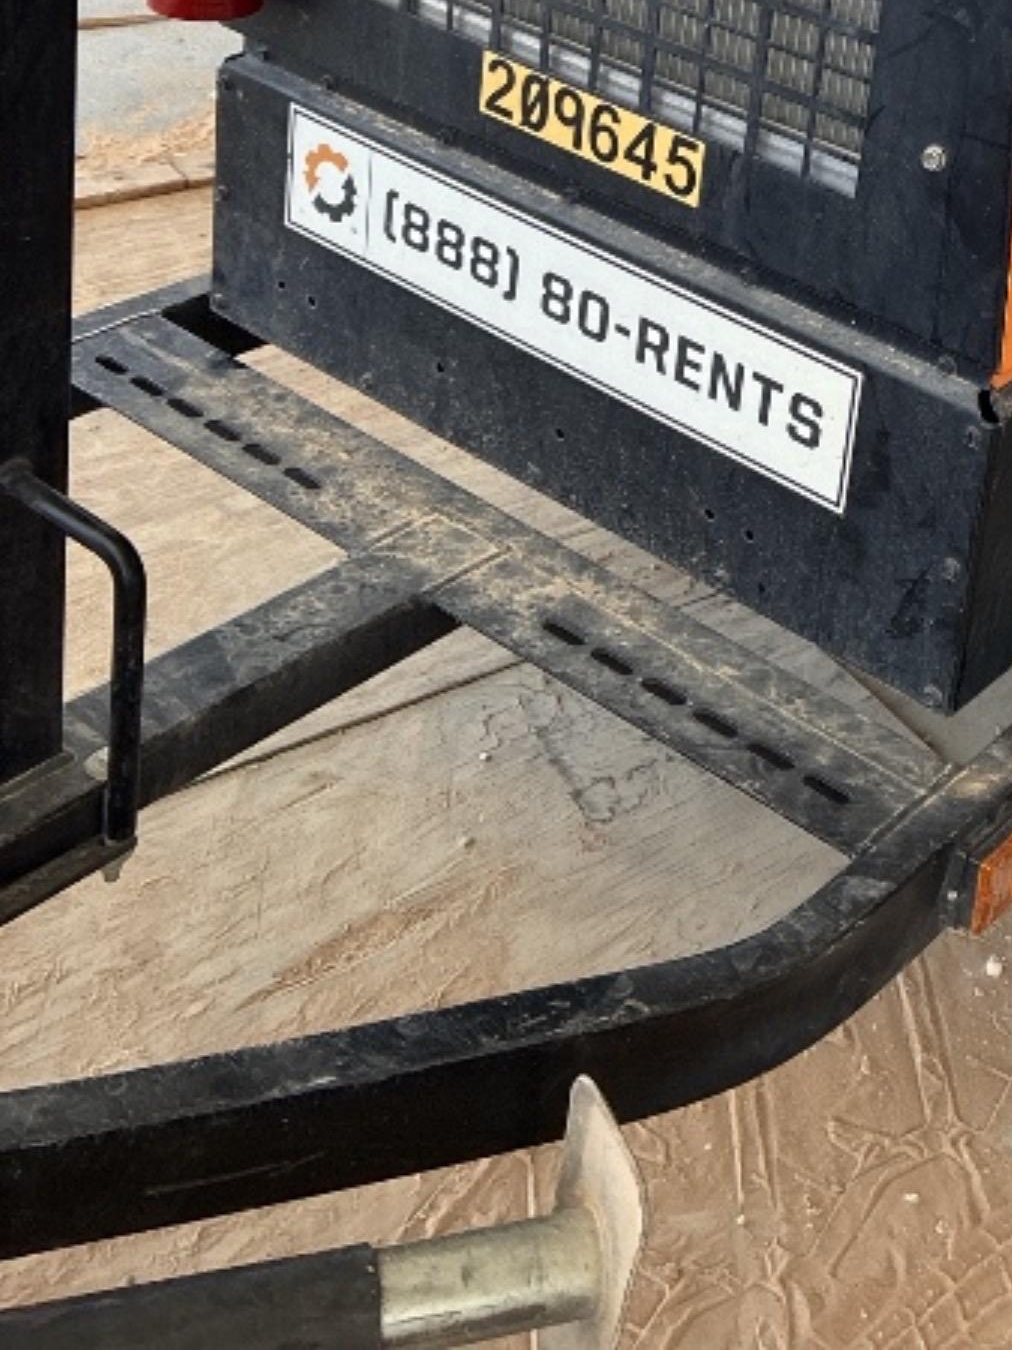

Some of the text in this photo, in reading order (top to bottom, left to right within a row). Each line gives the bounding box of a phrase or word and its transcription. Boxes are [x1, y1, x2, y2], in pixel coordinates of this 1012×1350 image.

[485, 58, 699, 197] 209645
[384, 189, 824, 450] (888) 80-RENTS
